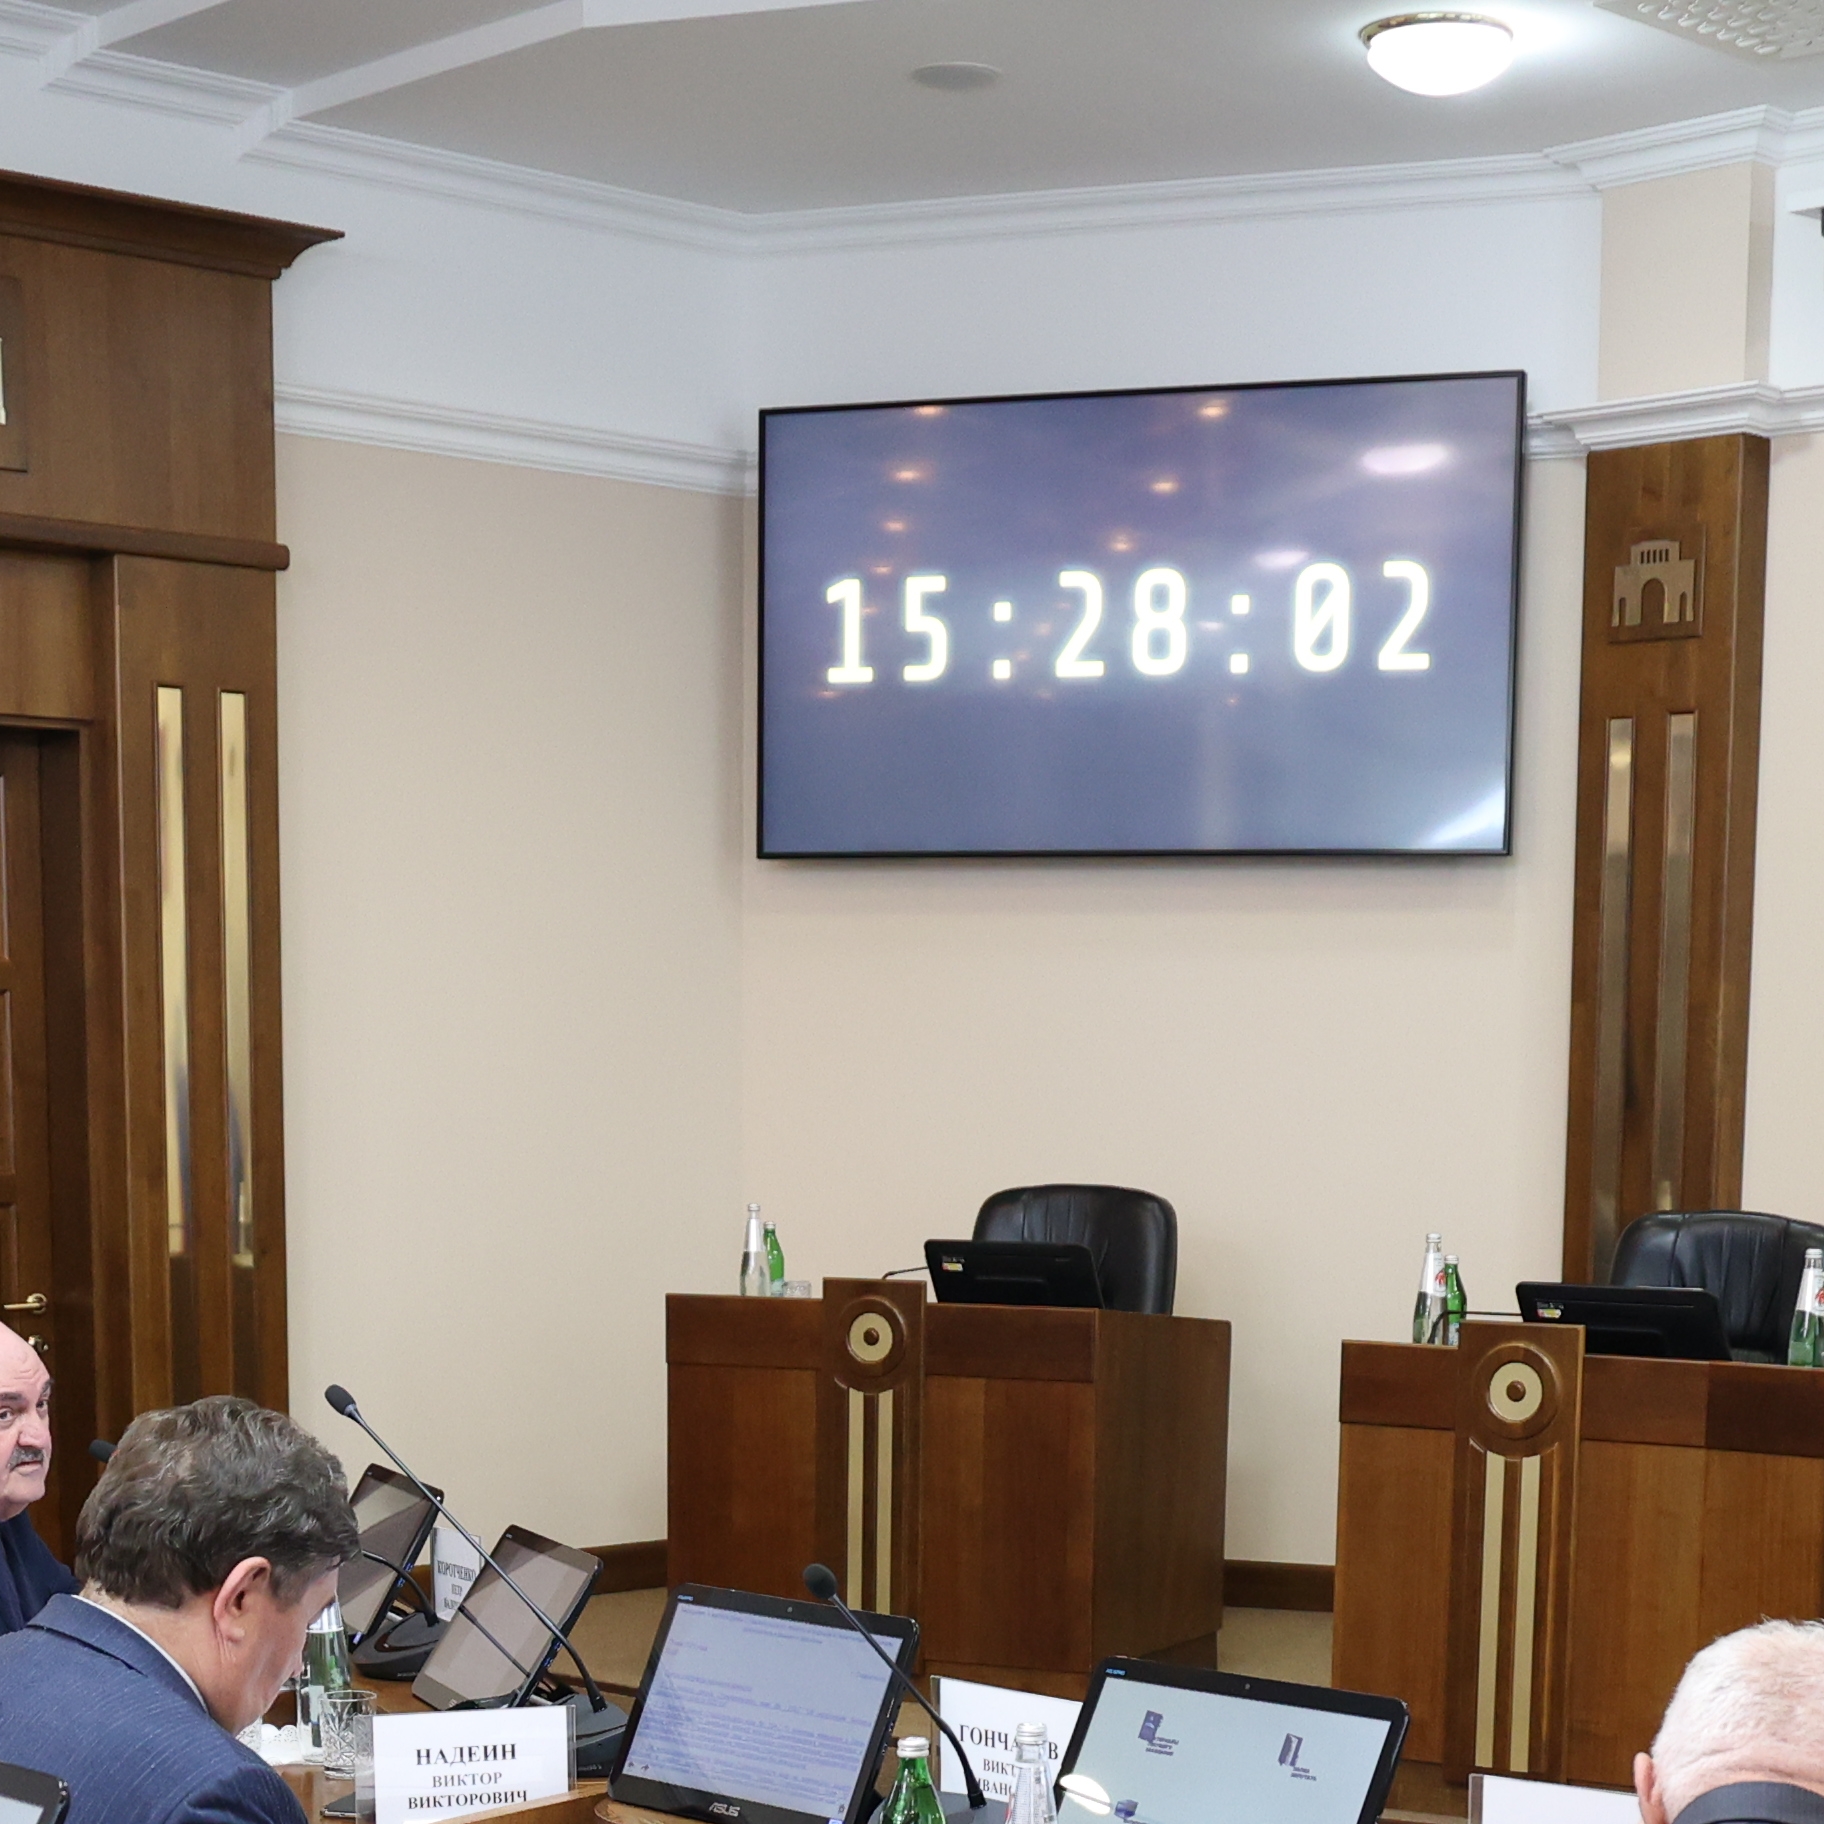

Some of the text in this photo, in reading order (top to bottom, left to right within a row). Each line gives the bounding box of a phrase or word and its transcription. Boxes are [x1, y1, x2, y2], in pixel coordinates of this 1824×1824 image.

[825, 560, 1433, 684] 15:28:02
[959, 1724, 1059, 1760] ГОНЧВ
[416, 1743, 518, 1767] НАДЕИН
[432, 1772, 502, 1788] ВИКТОР
[408, 1790, 528, 1810] ВИКТОРОВИЧ
[709, 1803, 740, 1817] ASUS
